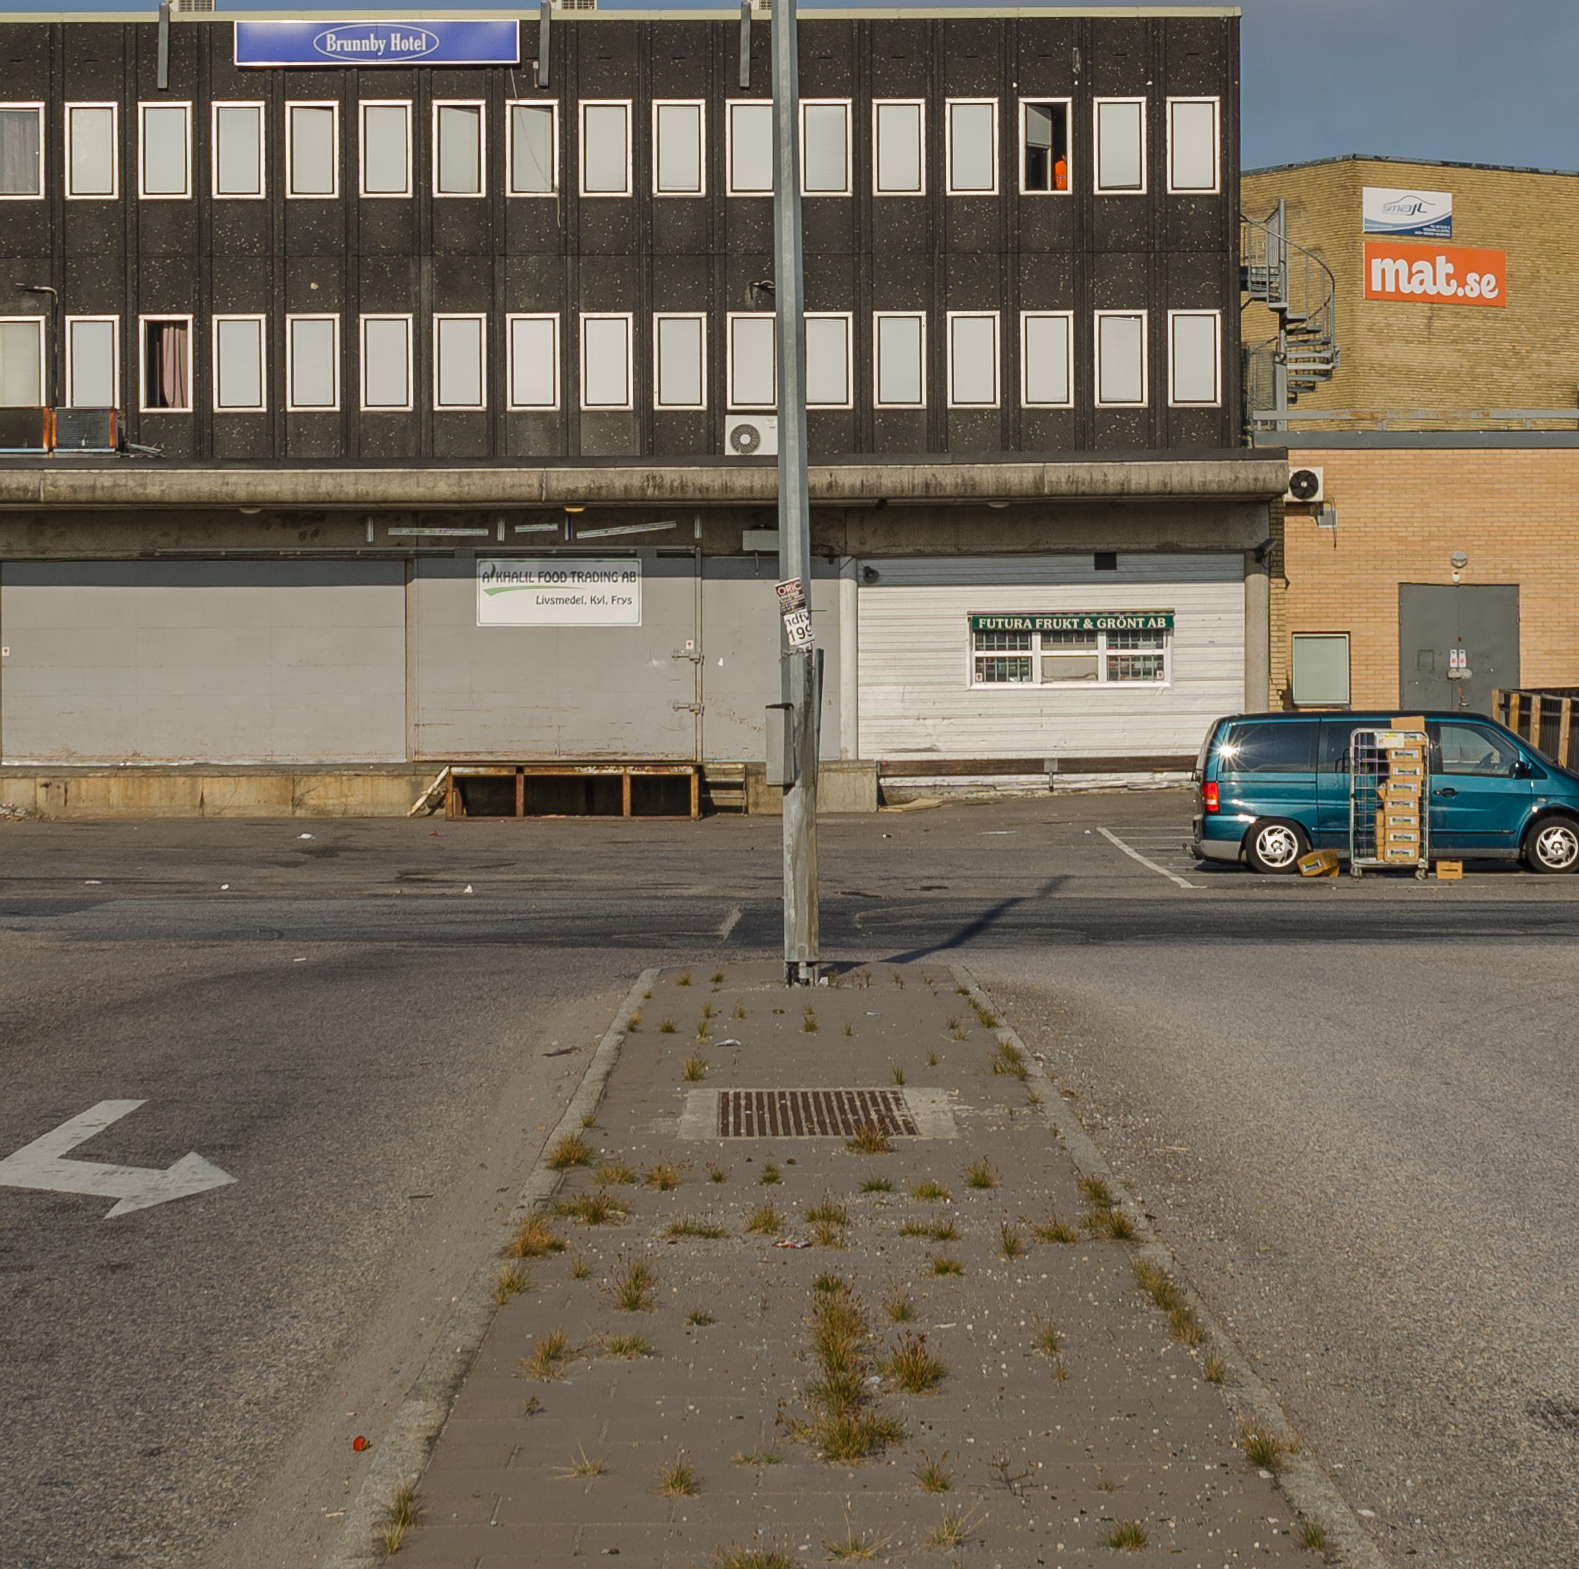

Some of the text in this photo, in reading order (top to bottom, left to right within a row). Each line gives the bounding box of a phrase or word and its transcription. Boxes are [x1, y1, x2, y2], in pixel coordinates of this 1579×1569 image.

[326, 33, 426, 55] Brunnby Hotel
[1371, 255, 1499, 299] mat.se
[538, 571, 567, 583] FOOD
[570, 571, 618, 583] TRADING
[621, 571, 637, 583] AB
[611, 595, 633, 606] Frys
[978, 615, 1167, 629] FUTURA FRUKT & GRÖNT AB
